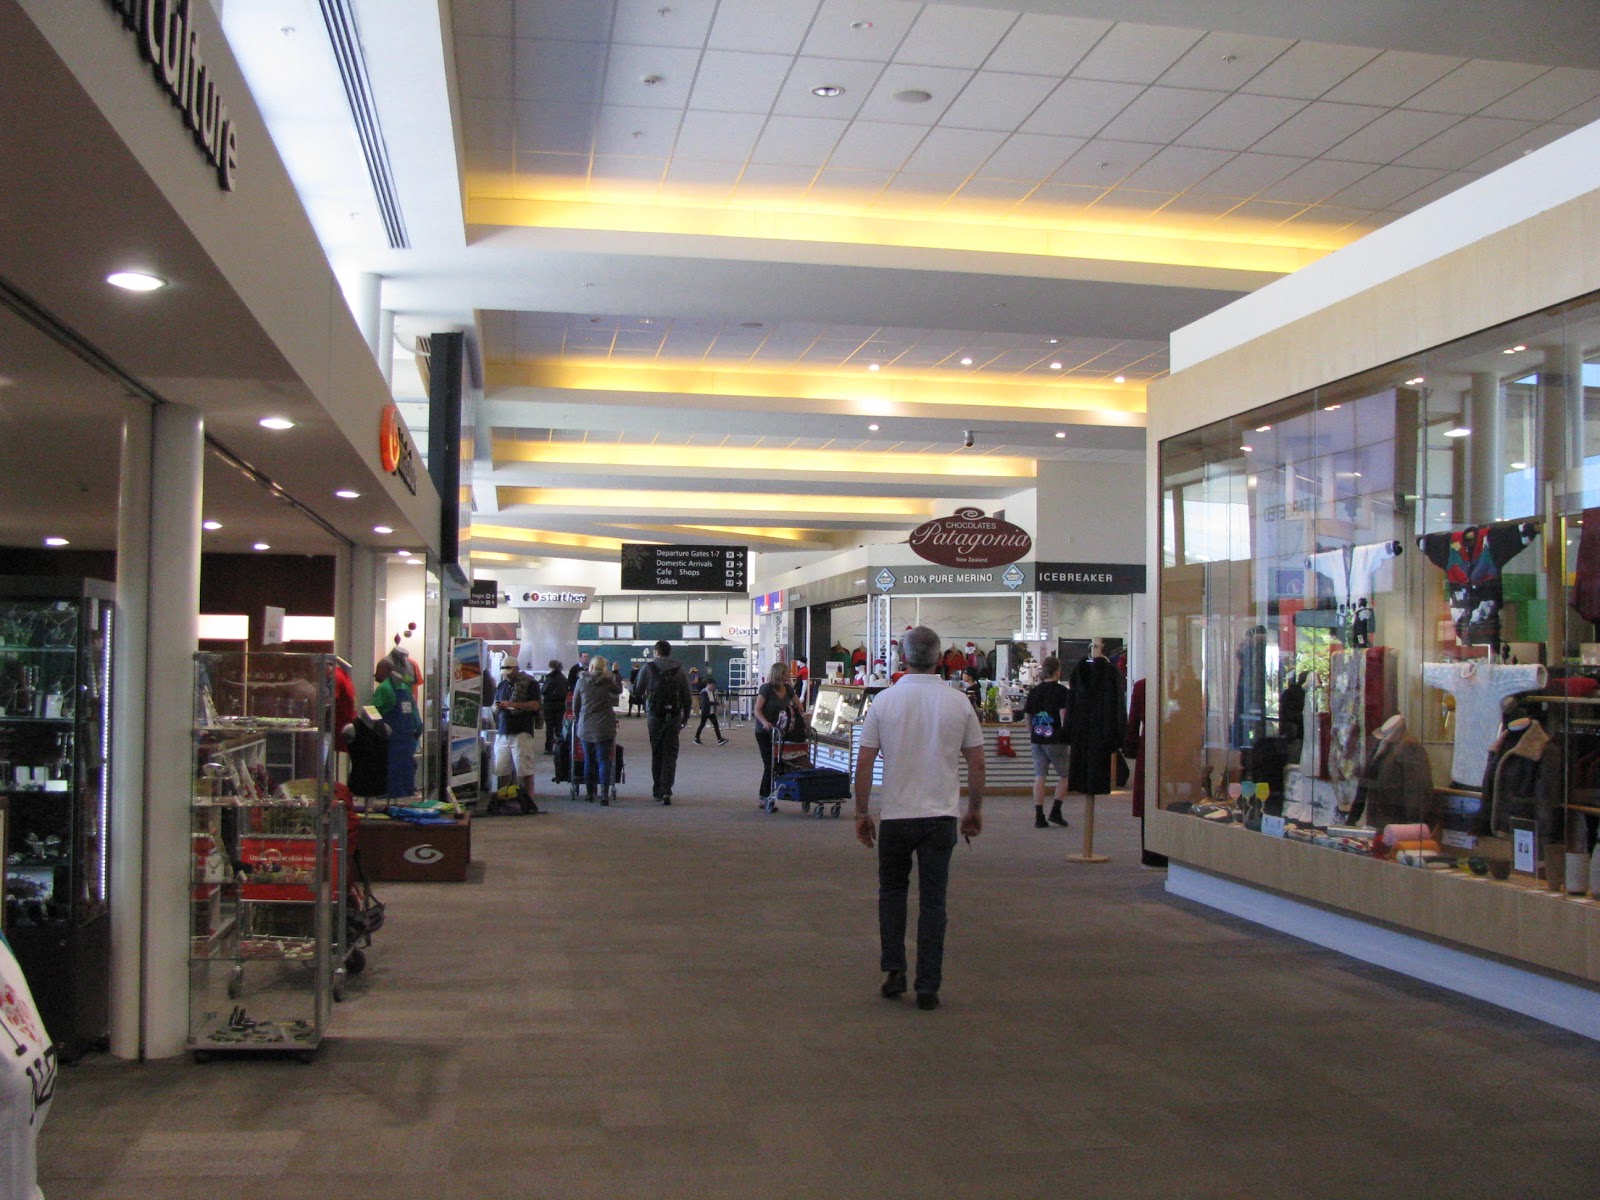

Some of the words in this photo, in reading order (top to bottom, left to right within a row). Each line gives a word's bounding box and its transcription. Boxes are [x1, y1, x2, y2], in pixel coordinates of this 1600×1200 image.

[945, 521, 997, 530] CHOCOLATES
[911, 521, 1031, 555] Patagonia
[656, 549, 689, 558] Departure
[690, 550, 709, 558] Gates
[710, 550, 720, 558] 1-7
[656, 559, 687, 567] Domestic
[688, 560, 713, 568] Arrivals
[656, 568, 672, 576] Cafe
[679, 568, 700, 577] Shops
[1039, 572, 1113, 583] ICEBREAKER
[656, 577, 678, 585] Toilets
[903, 575, 927, 584] 100%
[929, 574, 954, 583] PURE
[956, 573, 993, 583] MERINO
[541, 592, 567, 602] start
[567, 592, 587, 603] here
[774, 615, 782, 648] Exchange
